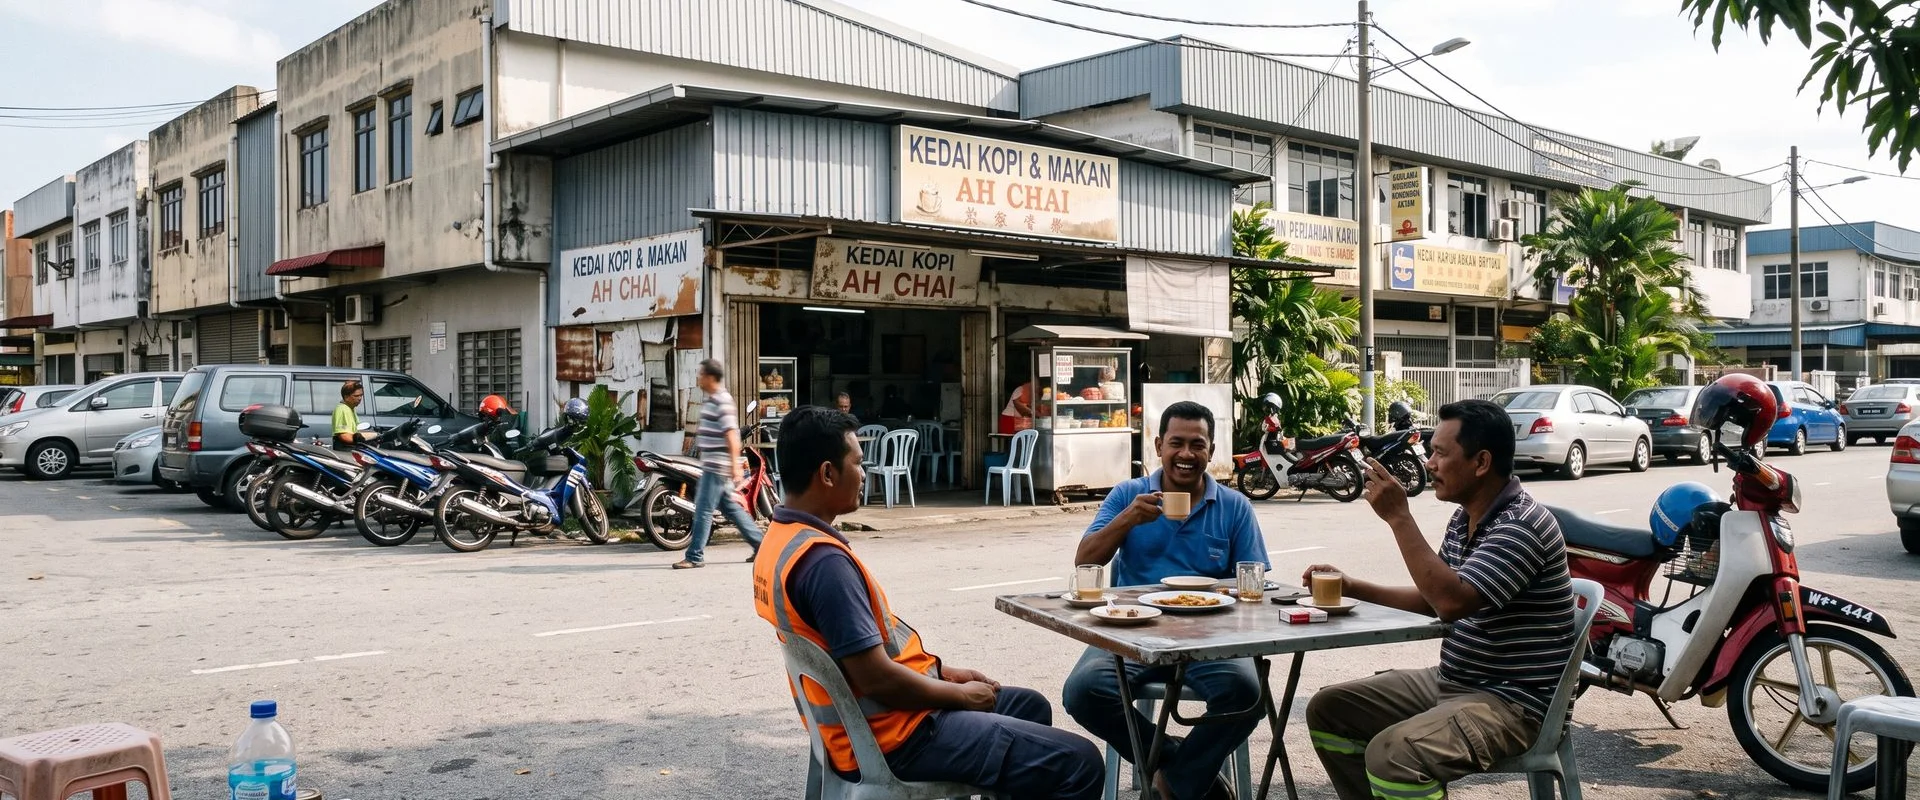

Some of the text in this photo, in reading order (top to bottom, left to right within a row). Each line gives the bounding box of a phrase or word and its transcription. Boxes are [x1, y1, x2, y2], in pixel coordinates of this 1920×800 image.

[910, 134, 1111, 189] KEDAI KOPI & MAKAN
[956, 177, 1070, 214] AH CHAI
[573, 240, 688, 277] KEDAI KOPI & MAKAN
[846, 246, 955, 271] KEDAI KOPI
[591, 273, 657, 303] AH CHAI
[841, 269, 956, 299] AH CHAI
[1841, 604, 1873, 623] 444
